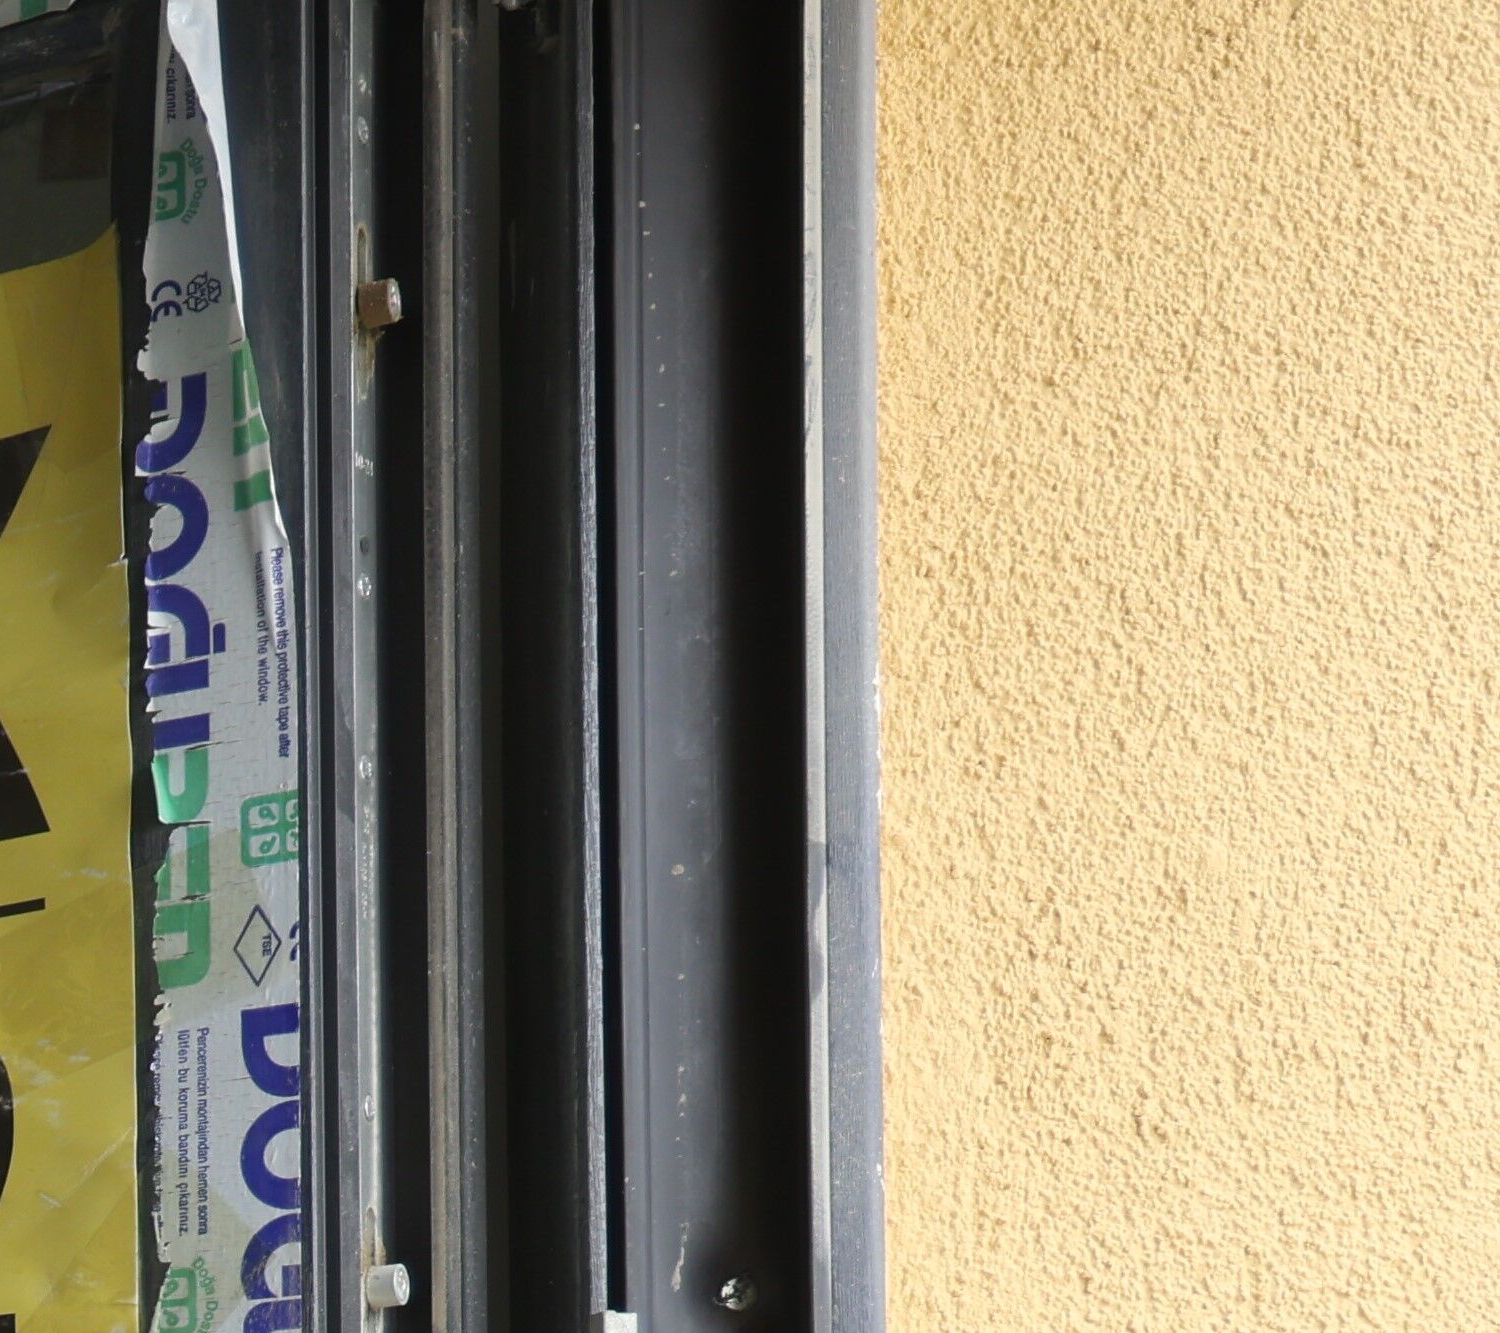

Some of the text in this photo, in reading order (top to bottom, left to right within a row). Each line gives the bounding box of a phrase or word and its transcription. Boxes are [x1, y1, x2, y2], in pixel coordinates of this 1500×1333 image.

[257, 621, 269, 634] of
[257, 636, 269, 654] the
[270, 547, 292, 758] Please remove this protective tape after
[258, 658, 271, 706] window.
[262, 934, 273, 957] TSE
[177, 1068, 191, 1084] bu
[177, 1088, 190, 1131] koruma
[195, 1027, 210, 1236] Pencerenizin montajından hemen sonra
